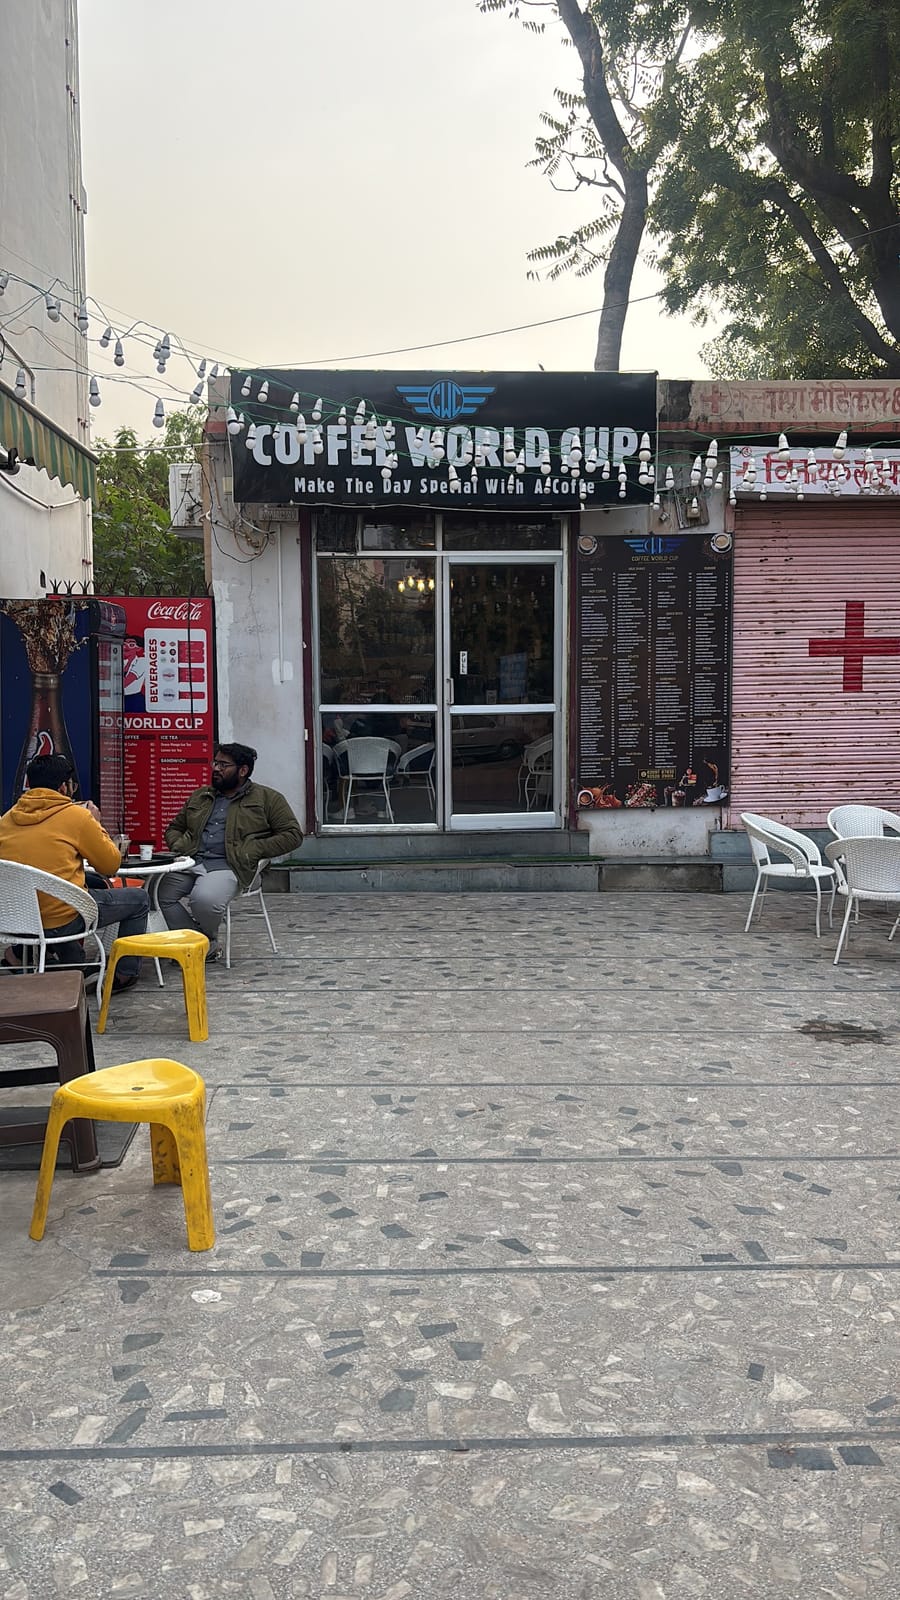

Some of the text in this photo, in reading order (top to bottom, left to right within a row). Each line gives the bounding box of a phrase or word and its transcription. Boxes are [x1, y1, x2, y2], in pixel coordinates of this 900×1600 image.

[252, 425, 638, 468] COFFEE WORLD CUP
[294, 477, 335, 493] Make
[346, 478, 374, 493] The
[383, 478, 412, 494] Day
[534, 478, 543, 494] A
[147, 601, 205, 621] Coca-Cola
[149, 638, 158, 703] BEVERAGES
[175, 718, 204, 729] CUP
